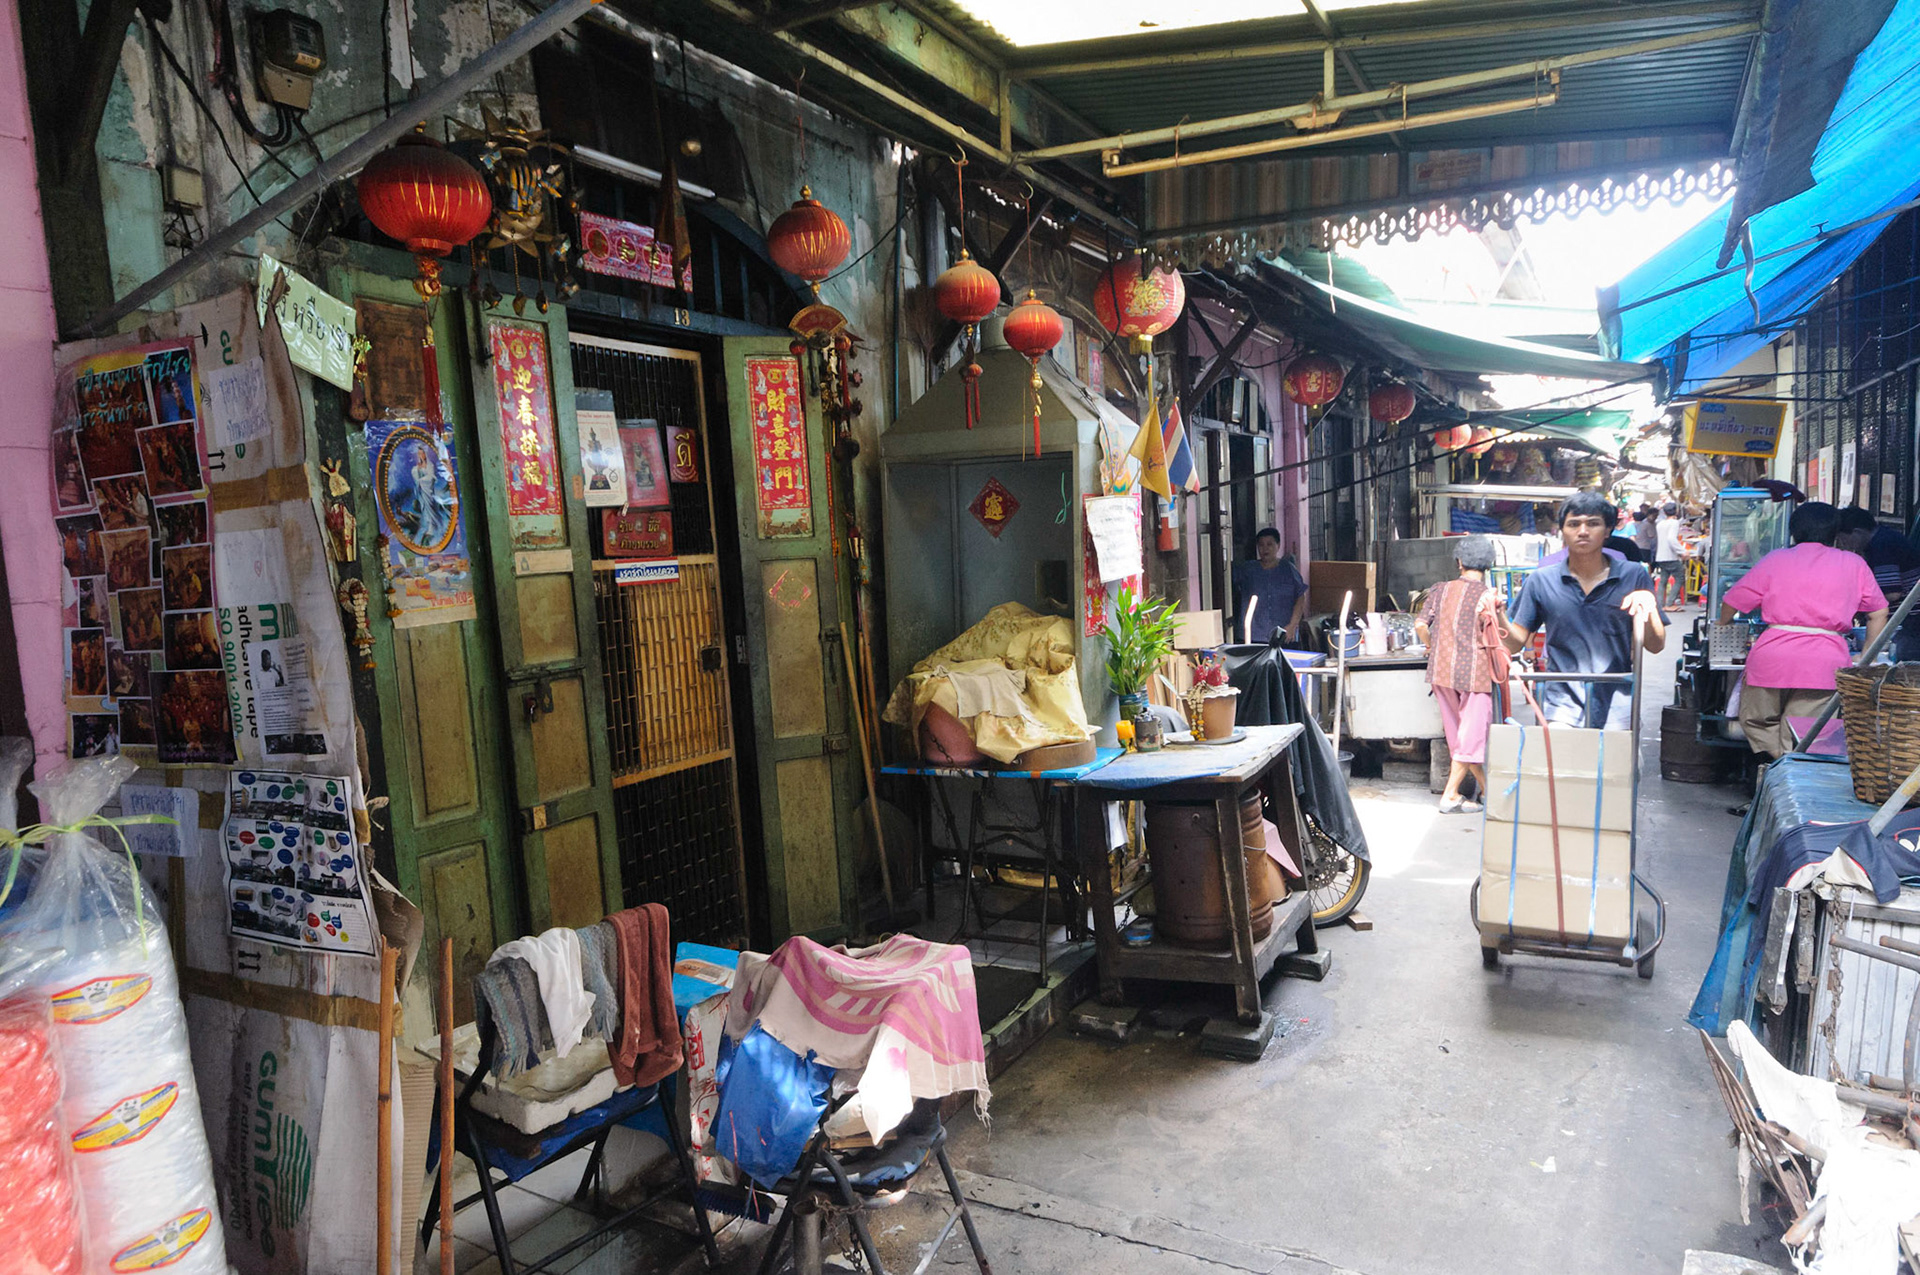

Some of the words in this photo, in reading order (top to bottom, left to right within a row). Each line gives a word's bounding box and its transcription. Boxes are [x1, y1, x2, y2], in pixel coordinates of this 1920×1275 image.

[674, 431, 692, 467] ดี
[766, 388, 793, 489] 財喜登門
[219, 608, 233, 635] SO
